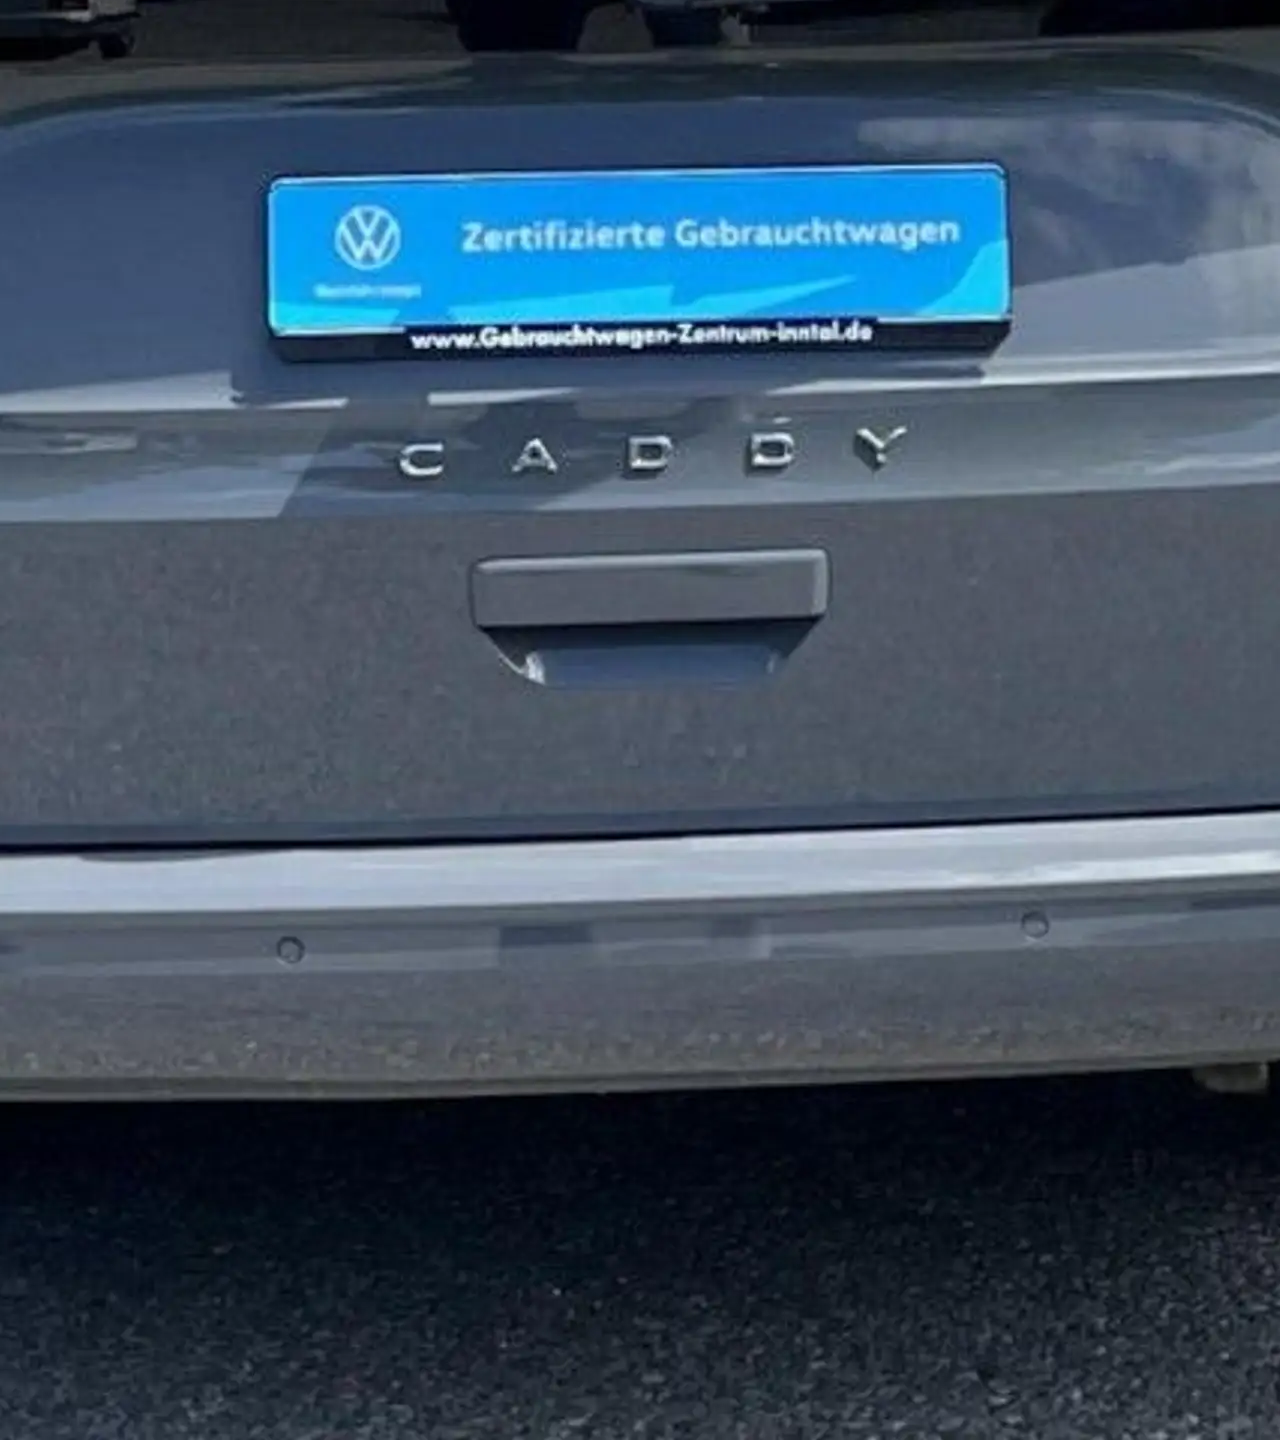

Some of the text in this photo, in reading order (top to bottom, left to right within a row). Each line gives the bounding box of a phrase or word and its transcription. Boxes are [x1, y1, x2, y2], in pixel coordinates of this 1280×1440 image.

[460, 218, 665, 254] Zertifizierte
[674, 216, 962, 252] Gebrauchtwagen
[398, 425, 908, 477] CADDY
